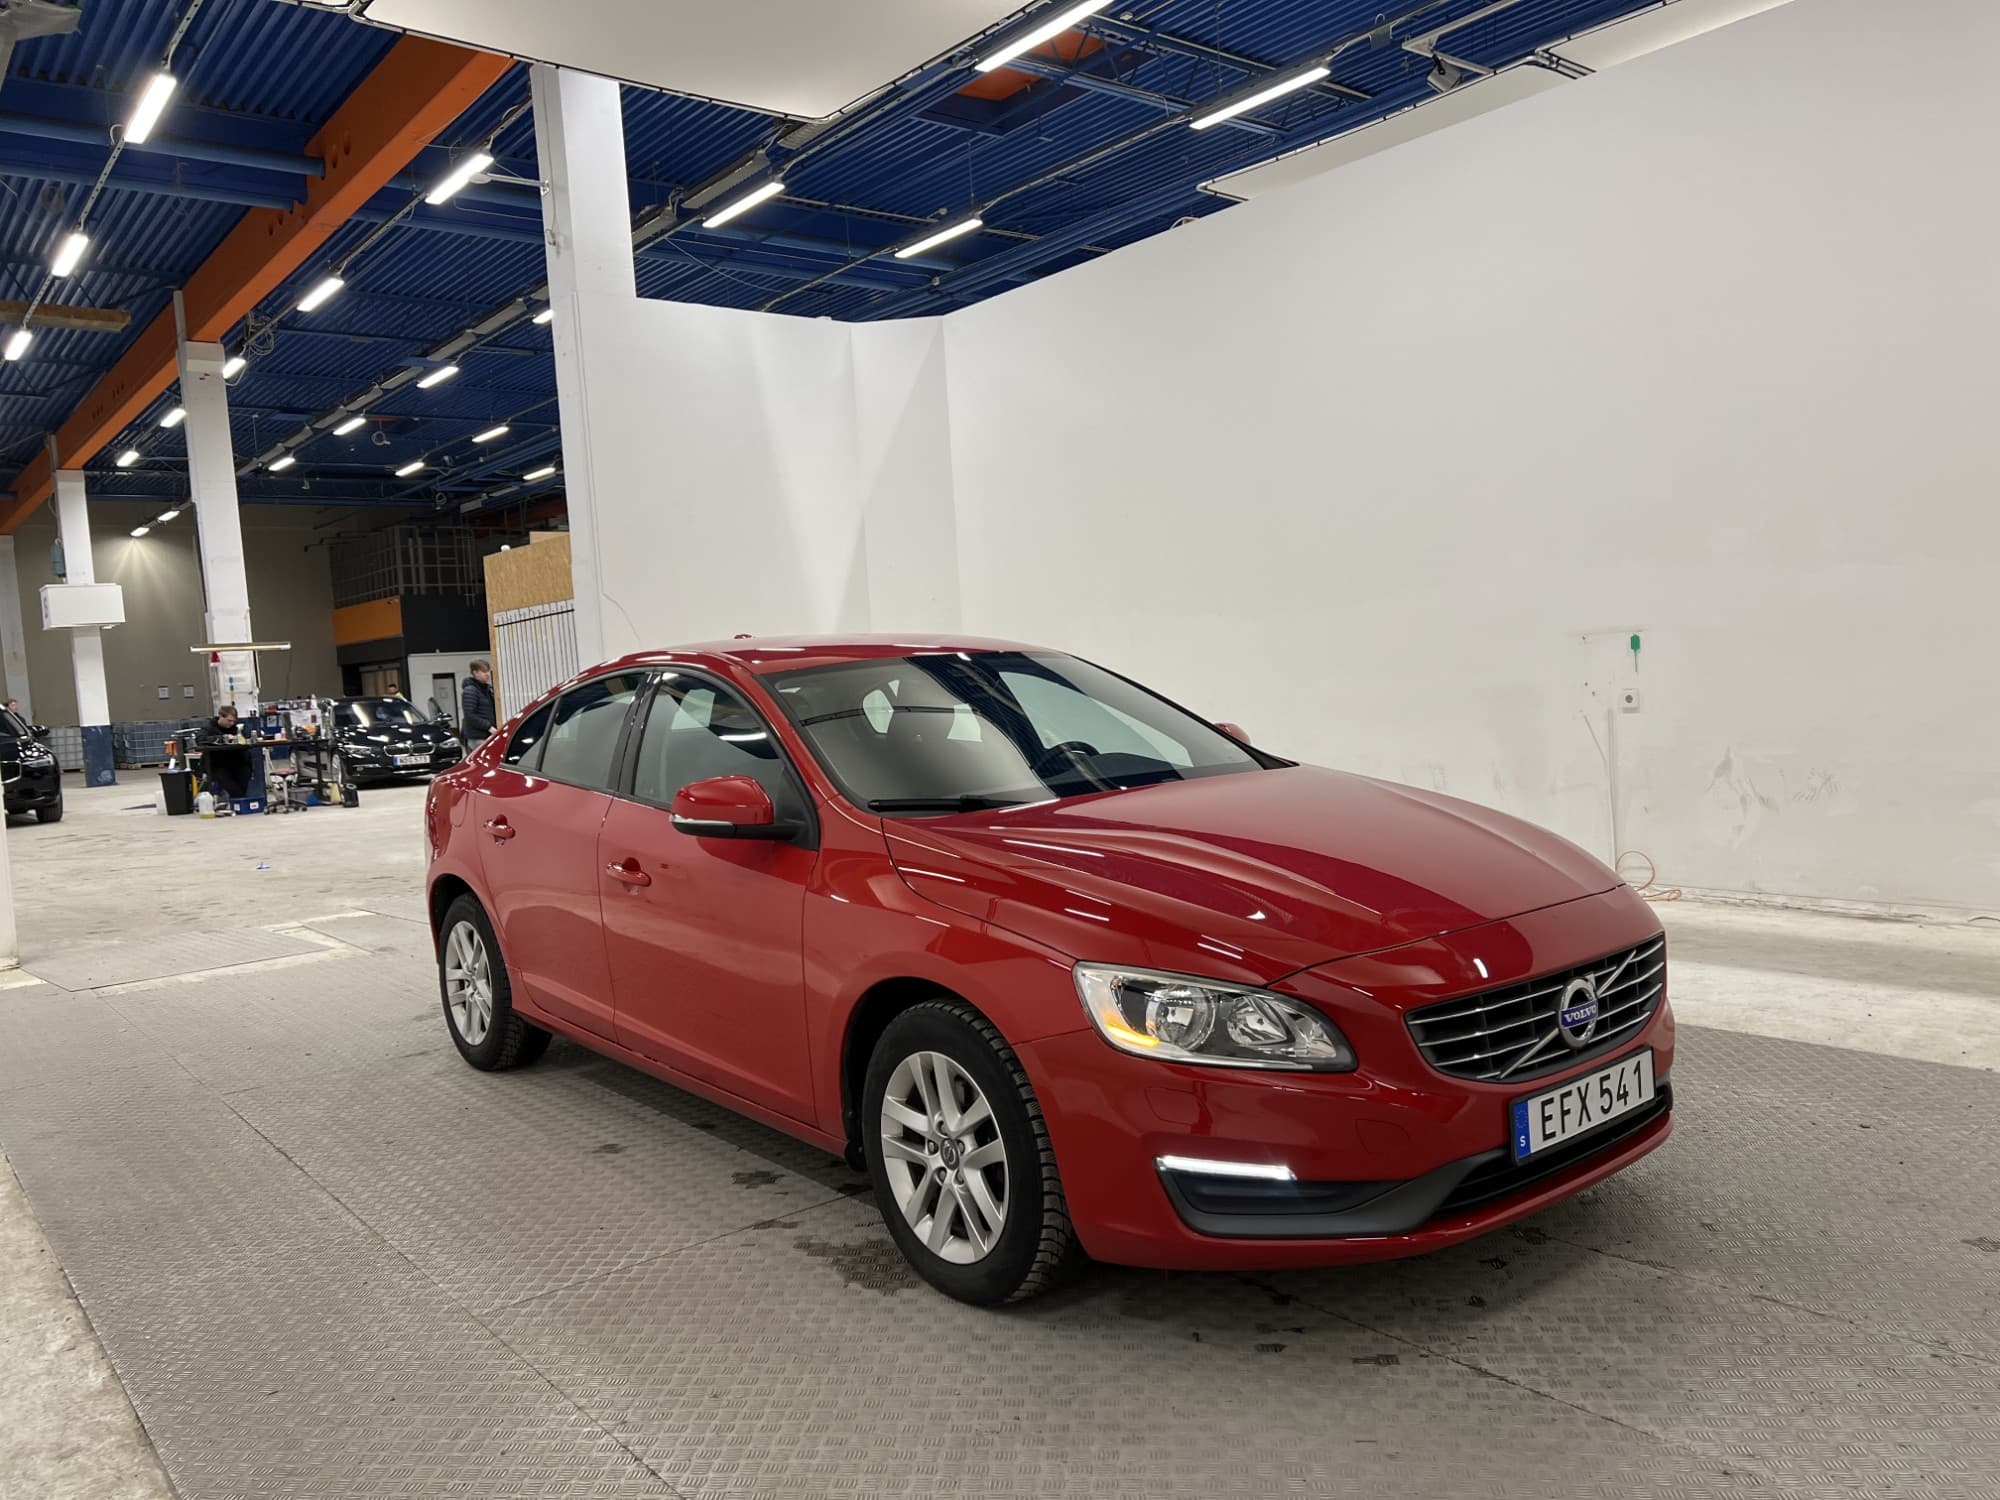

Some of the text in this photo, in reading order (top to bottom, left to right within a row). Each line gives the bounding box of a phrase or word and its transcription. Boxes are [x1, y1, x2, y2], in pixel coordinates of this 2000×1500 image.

[1564, 1005, 1597, 1023] VOLVO
[1541, 1060, 1643, 1142] EFX 541
[1519, 1135, 1526, 1147] S
